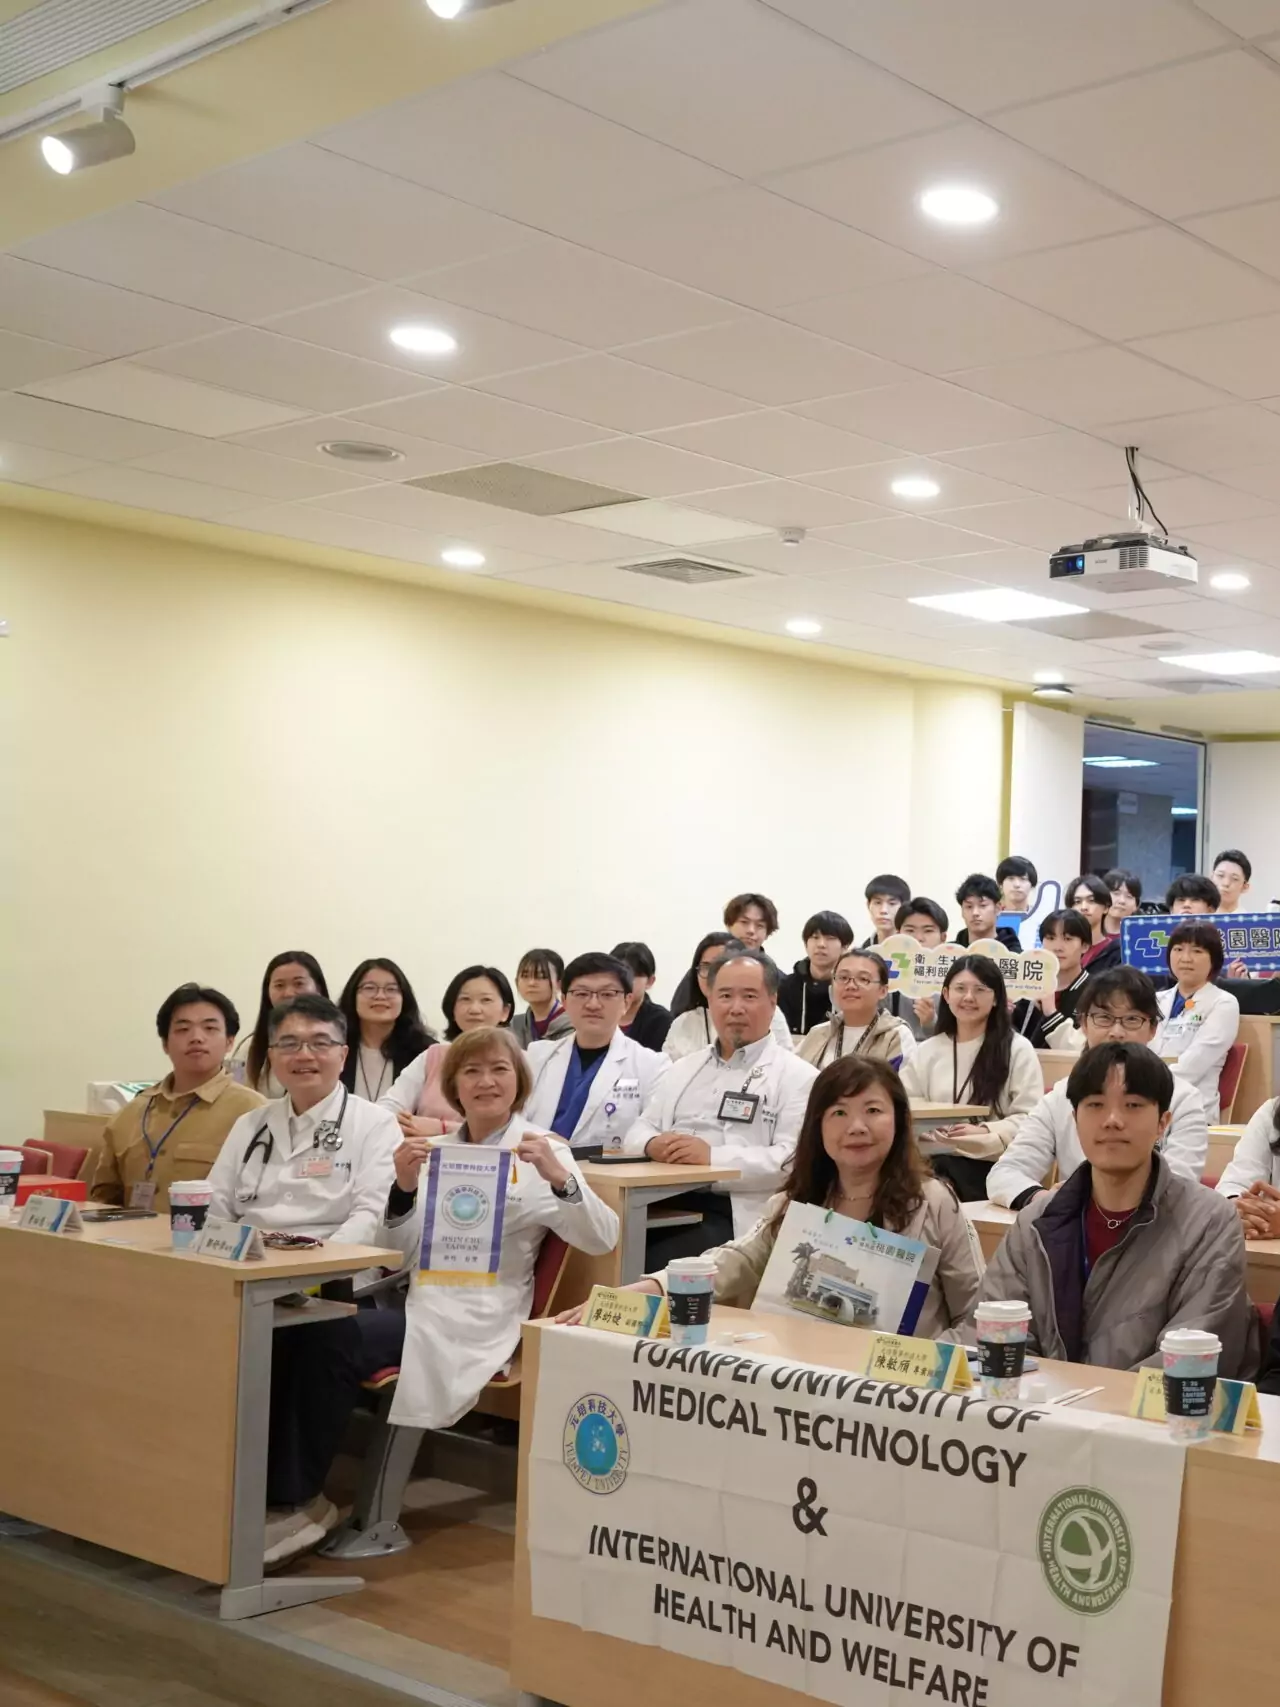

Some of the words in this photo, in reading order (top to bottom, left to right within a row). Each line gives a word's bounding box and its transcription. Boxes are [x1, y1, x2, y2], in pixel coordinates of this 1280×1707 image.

[632, 1339, 771, 1385] YUANPEI
[770, 1365, 987, 1422] UNIVERSITY
[986, 1405, 1051, 1433] OF
[632, 1379, 767, 1437] MEDICAL
[774, 1406, 1028, 1488] TECHNOLOGY
[792, 1477, 828, 1537] &
[1042, 1494, 1089, 1552] INTERNATIONAL
[1090, 1496, 1128, 1552] UNIVERSITY
[588, 1524, 814, 1612] INTERNATIONAL
[824, 1583, 1018, 1662] UNIVERSITY
[1026, 1636, 1080, 1678] OF
[1048, 1560, 1072, 1598] HEALTH
[653, 1583, 756, 1643] HEALTH
[765, 1619, 832, 1664] AND
[841, 1637, 989, 1707] WELFARE
